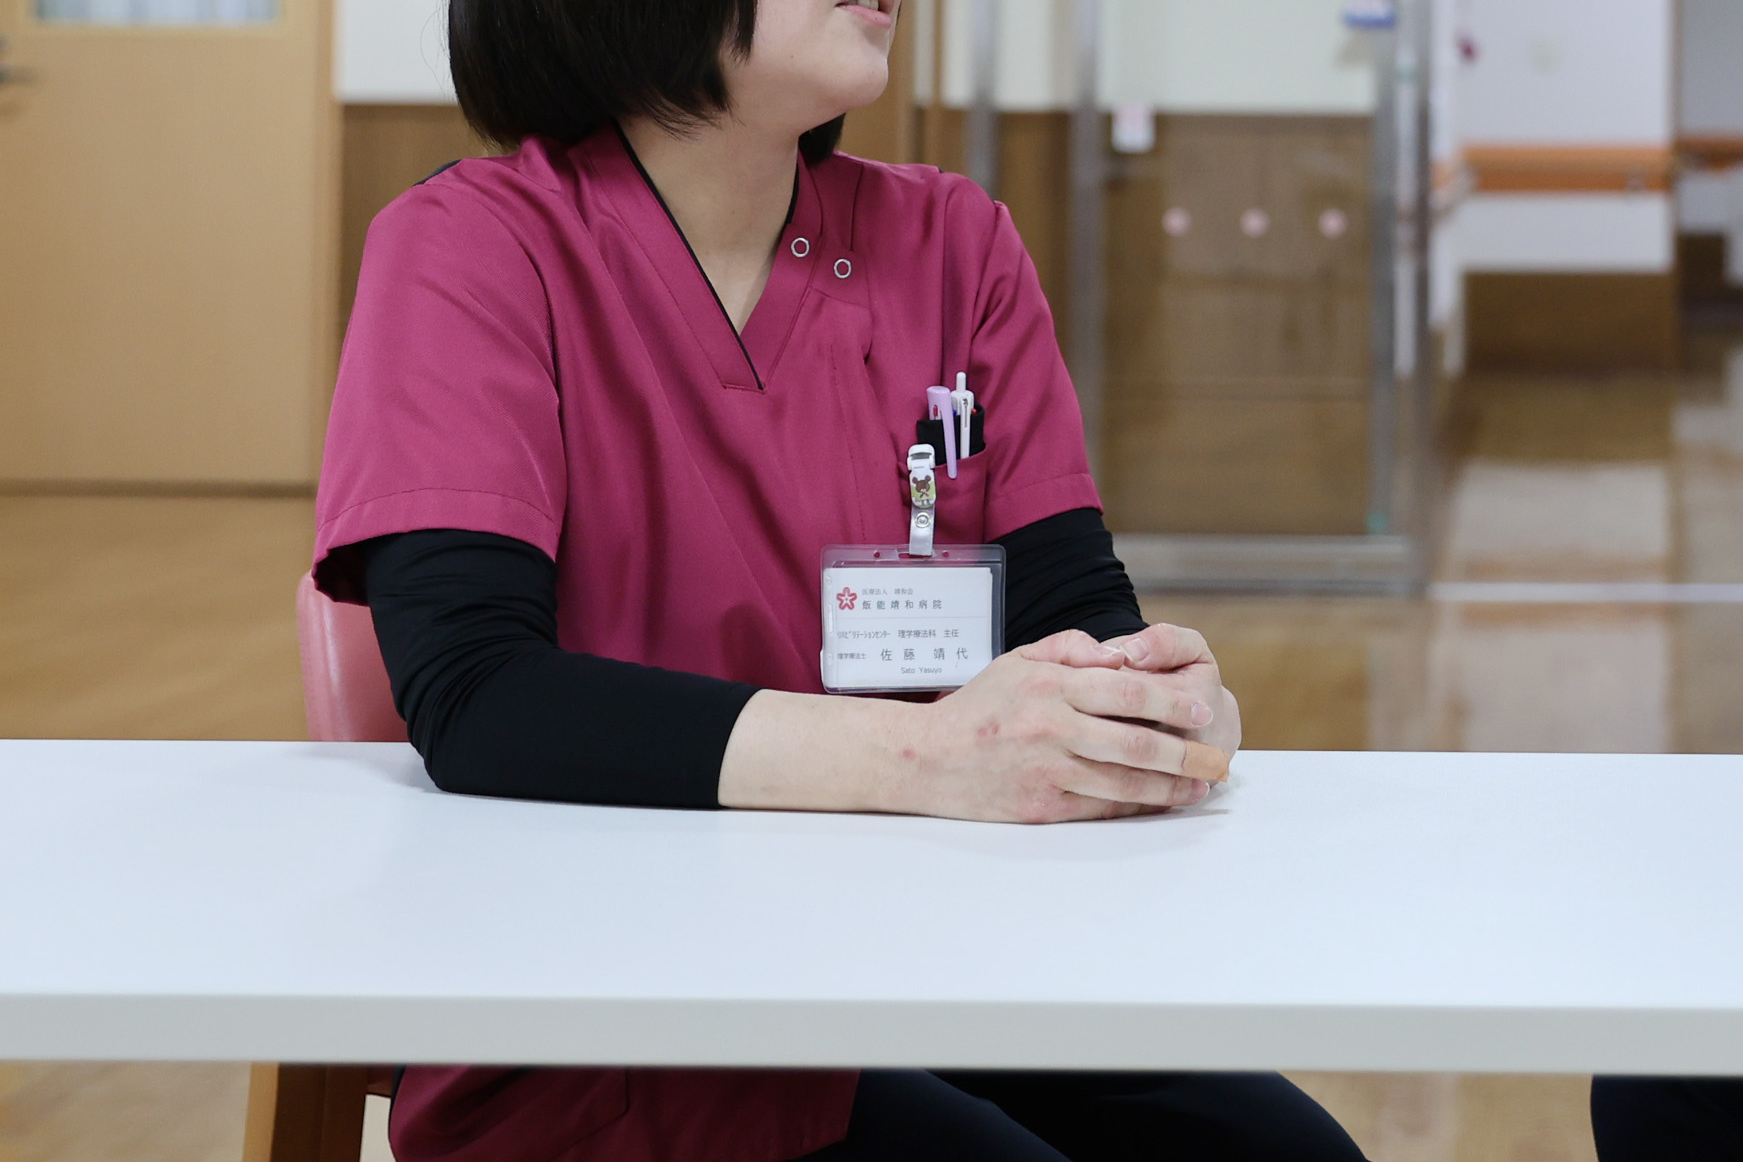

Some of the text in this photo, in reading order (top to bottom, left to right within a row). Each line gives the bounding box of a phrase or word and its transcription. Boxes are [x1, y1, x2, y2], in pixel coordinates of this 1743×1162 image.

[862, 599, 943, 610] 飯能靖和病院
[898, 629, 937, 638] 理学療法科
[943, 629, 960, 638] 主任
[900, 666, 943, 675] Sato Yasuyo
